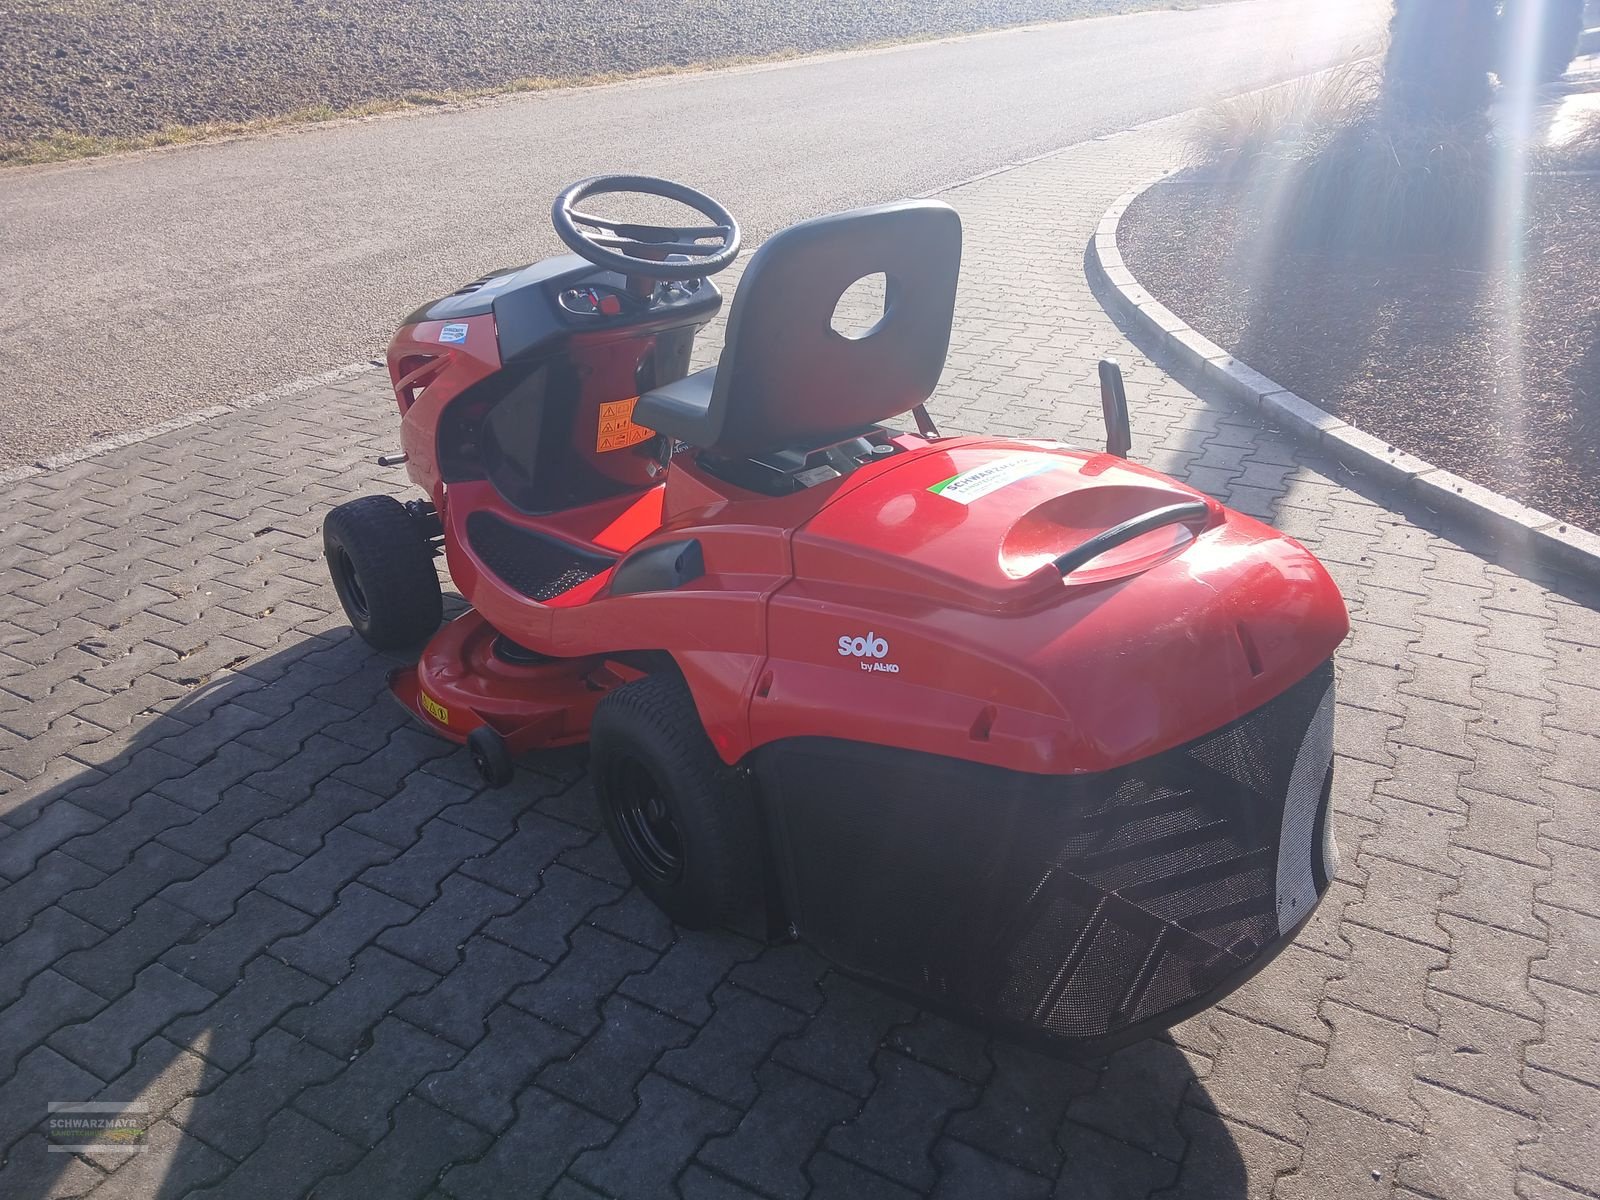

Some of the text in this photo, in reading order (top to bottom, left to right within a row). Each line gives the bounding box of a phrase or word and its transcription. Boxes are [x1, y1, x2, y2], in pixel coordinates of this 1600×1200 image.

[837, 631, 889, 658] solo
[861, 661, 900, 673] by AL-KO
